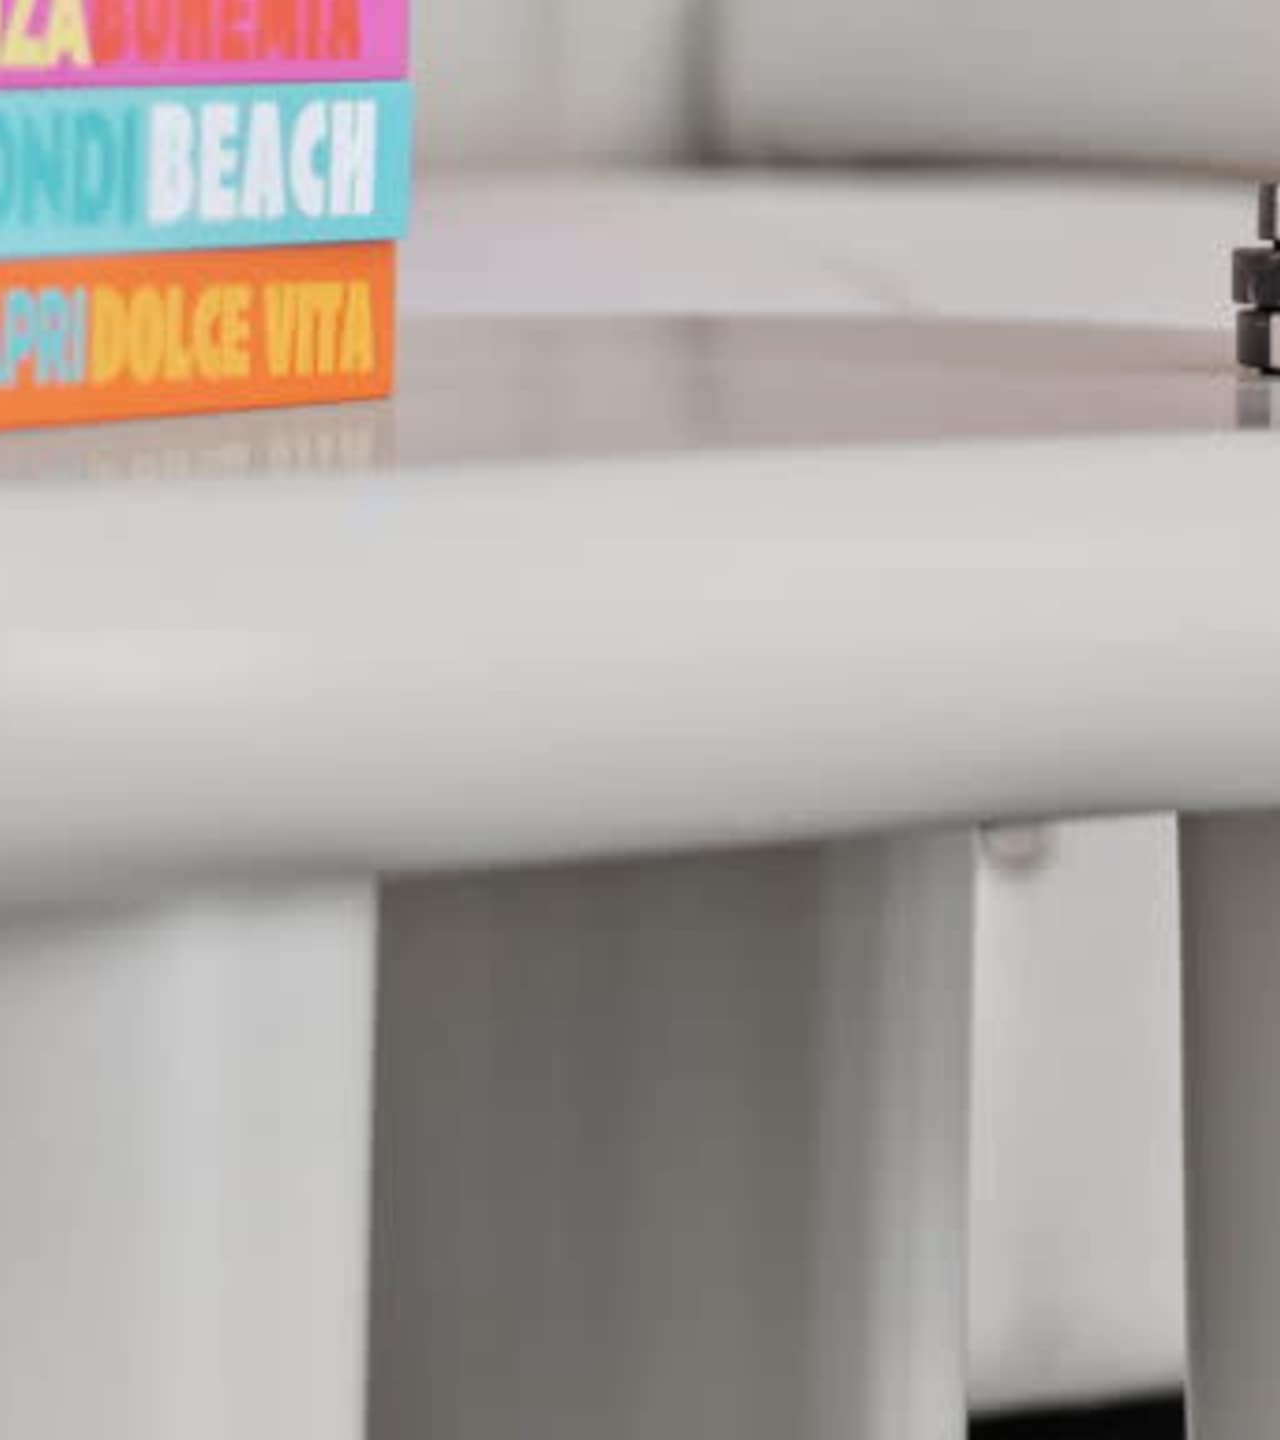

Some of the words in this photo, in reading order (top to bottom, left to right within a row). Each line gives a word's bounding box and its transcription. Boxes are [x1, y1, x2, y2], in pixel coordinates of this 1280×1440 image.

[147, 99, 378, 228] BEACH
[90, 281, 252, 385] DOLCE
[263, 278, 376, 378] VITA
